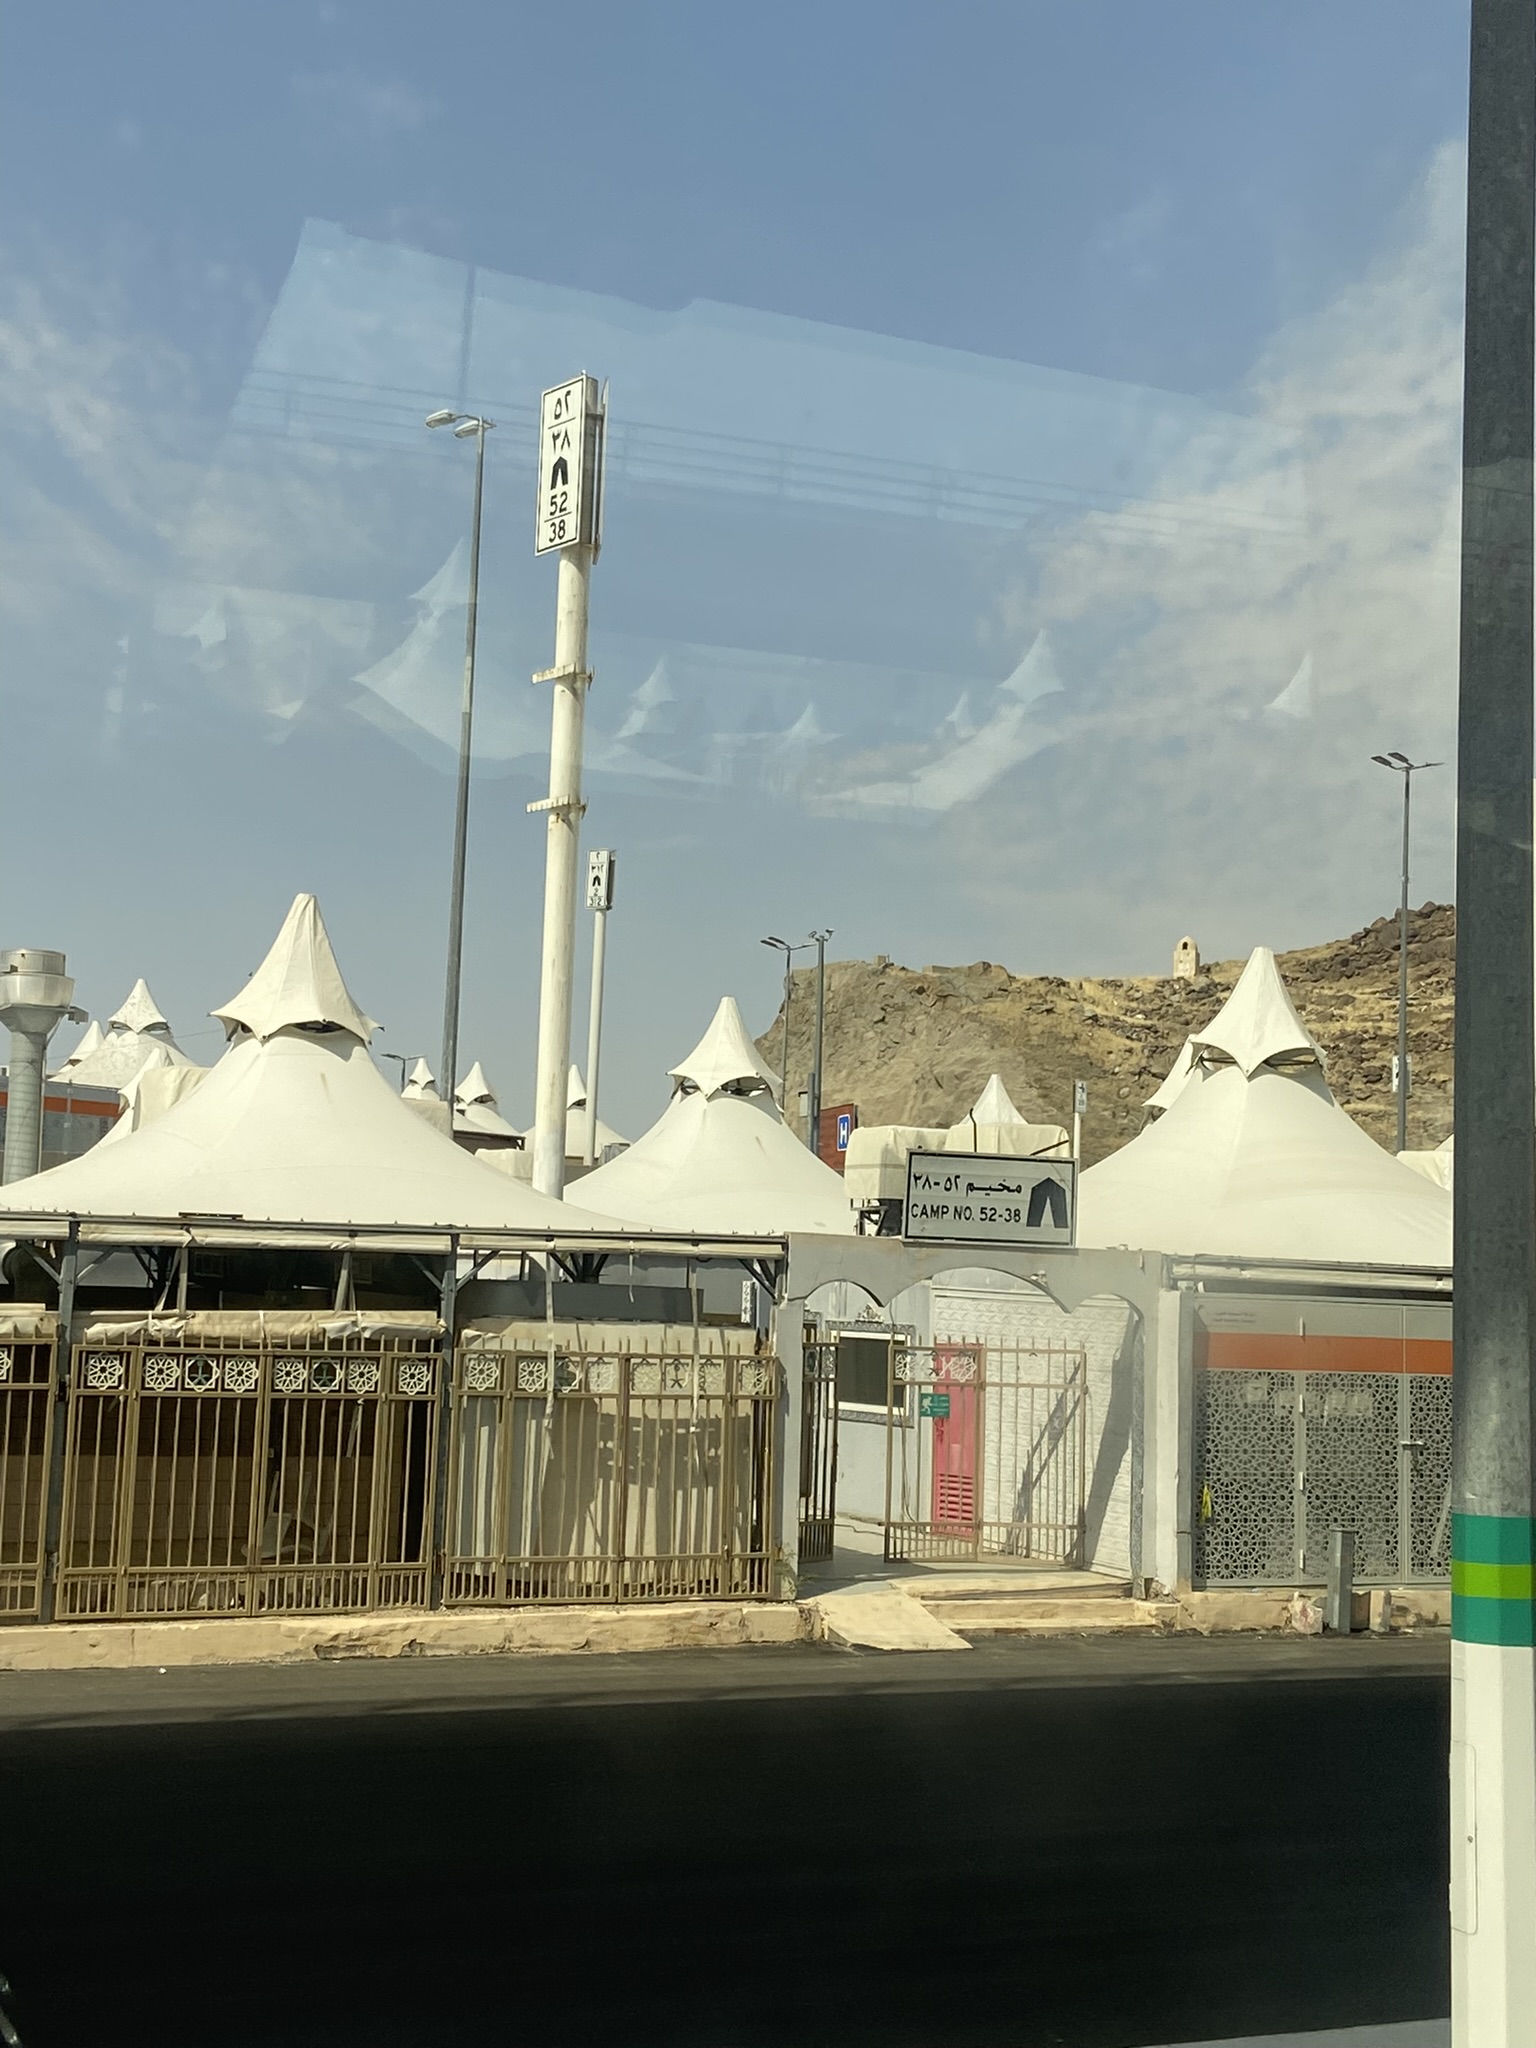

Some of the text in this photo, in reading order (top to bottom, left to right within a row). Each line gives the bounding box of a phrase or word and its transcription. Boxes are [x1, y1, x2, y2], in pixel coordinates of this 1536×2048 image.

[554, 390, 571, 420] ٥٢
[552, 427, 571, 454] ٣٨
[549, 491, 568, 516] 52
[549, 519, 566, 542] 38
[840, 1121, 848, 1144] H
[966, 1179, 1022, 1197] مخيم
[911, 1203, 1021, 1223] CAMP NO. 52-38
